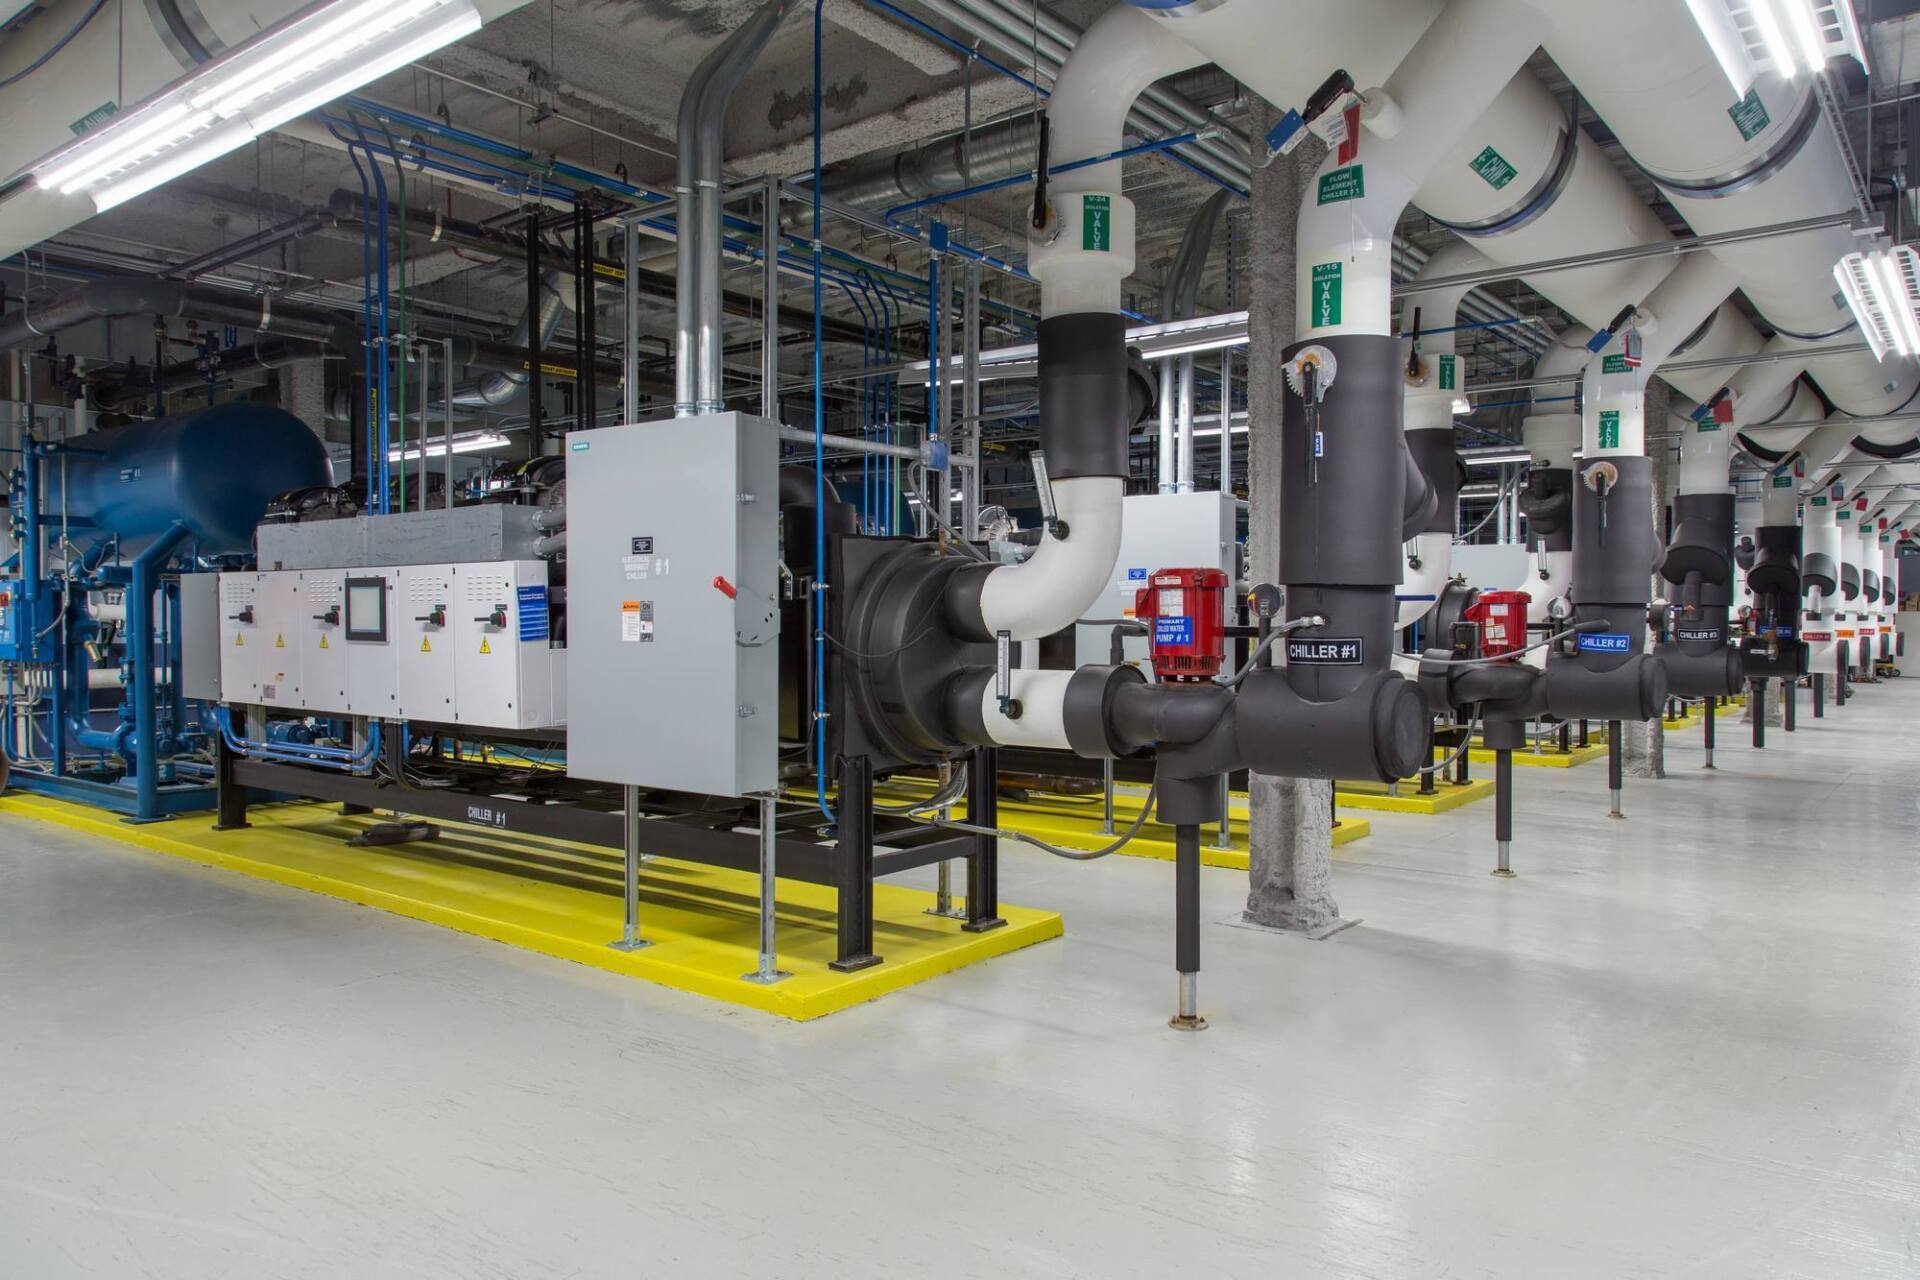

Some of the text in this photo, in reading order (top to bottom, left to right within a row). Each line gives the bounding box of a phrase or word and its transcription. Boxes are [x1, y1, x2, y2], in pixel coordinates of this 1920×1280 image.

[1480, 156, 1509, 183] CHW
[1329, 172, 1350, 182] FLOW
[1323, 179, 1357, 192] ELEMENT
[1321, 189, 1348, 200] CHILLER
[1093, 211, 1101, 250] VALVE
[1321, 281, 1331, 326] VALVE
[1156, 634, 1174, 642] PUMP
[1680, 631, 1708, 639] CHILLER
[1580, 637, 1614, 648] CHILLER
[1289, 644, 1356, 659] CHILLER #1
[467, 805, 492, 821] CHILLER
